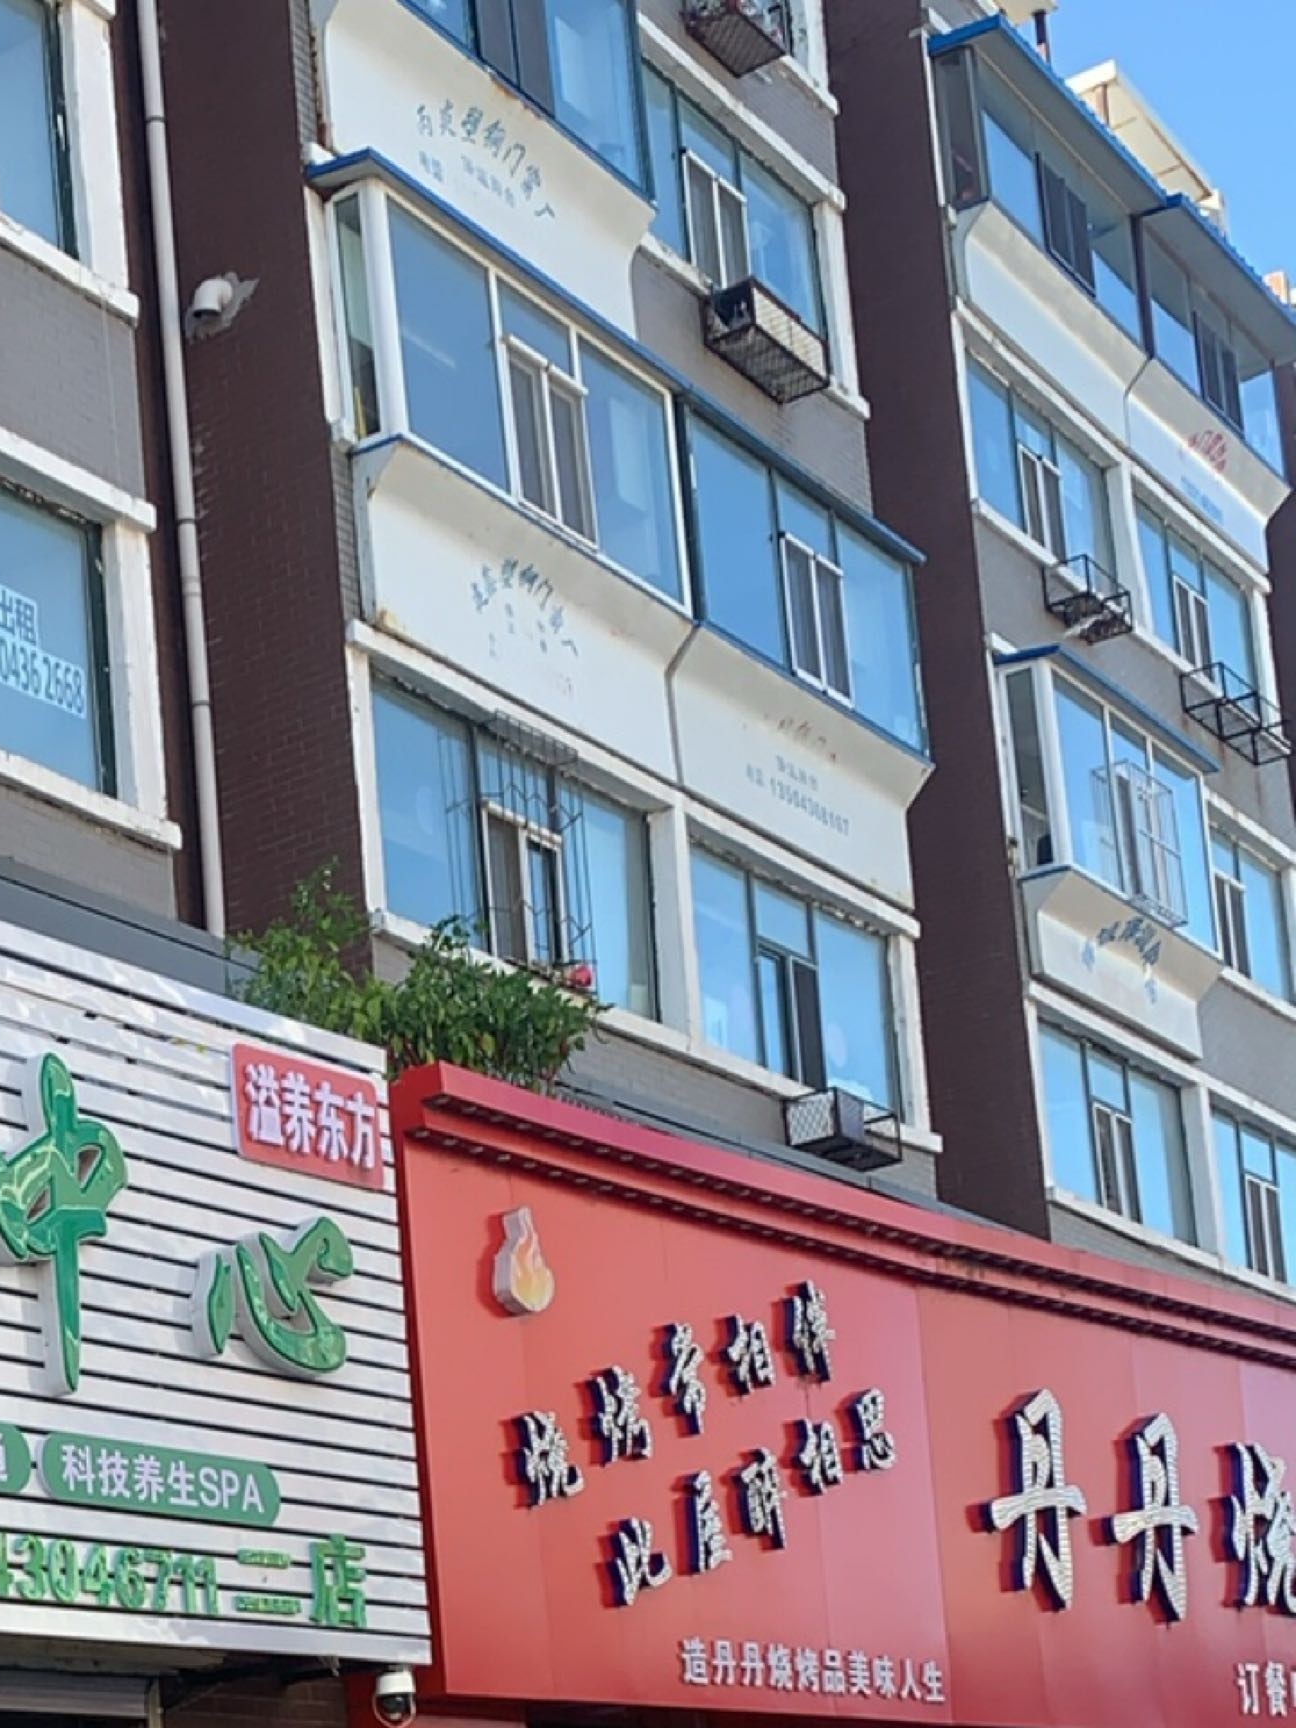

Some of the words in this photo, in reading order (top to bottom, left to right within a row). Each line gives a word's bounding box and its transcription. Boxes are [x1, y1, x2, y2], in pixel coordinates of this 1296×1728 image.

[245, 1062, 377, 1170] 溢养东方
[60, 1442, 266, 1514] 科技养生SPA
[236, 1534, 367, 1628] 二店
[680, 1636, 945, 1702] 造丹丹烧烤品美味人生
[1237, 1660, 1296, 1716] 订餐
